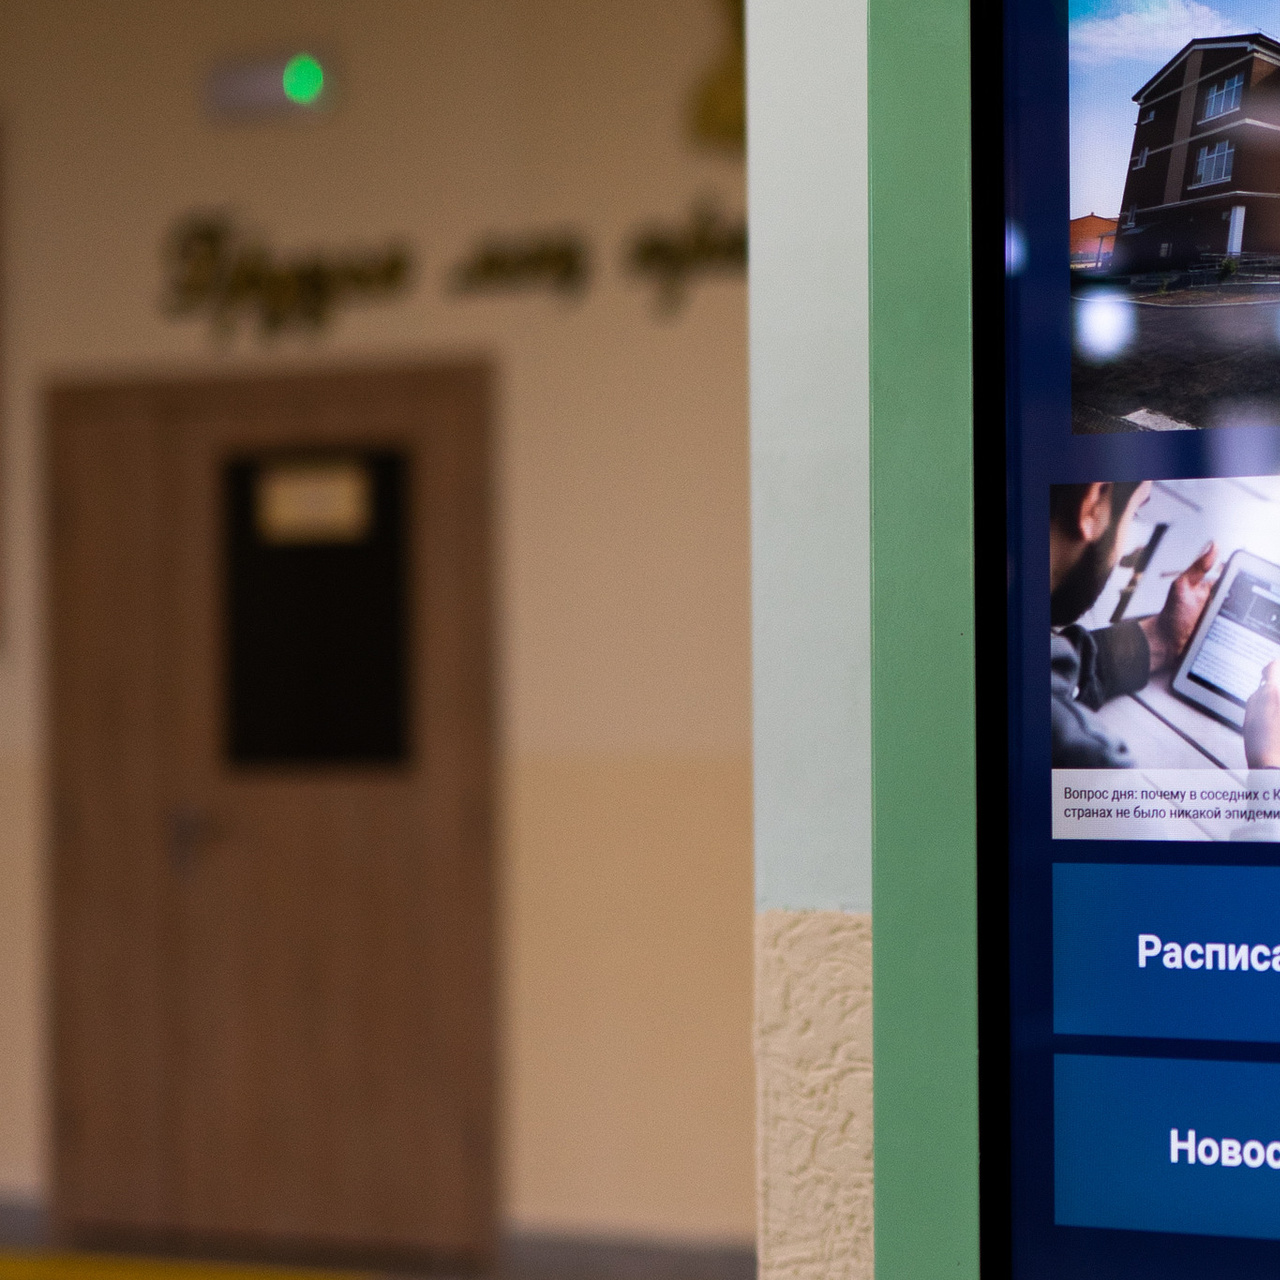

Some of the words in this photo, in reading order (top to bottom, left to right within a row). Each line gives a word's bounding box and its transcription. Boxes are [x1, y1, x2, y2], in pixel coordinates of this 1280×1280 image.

[1064, 787, 1109, 803] Вопрос
[1112, 789, 1138, 805] дня:
[1141, 789, 1187, 805] почему
[1189, 789, 1198, 801] в
[1200, 789, 1260, 804] соседних
[1262, 790, 1270, 802] с
[1064, 806, 1113, 822] странах
[1116, 806, 1131, 820] не
[1133, 805, 1167, 819] было
[1169, 805, 1222, 820] никакой
